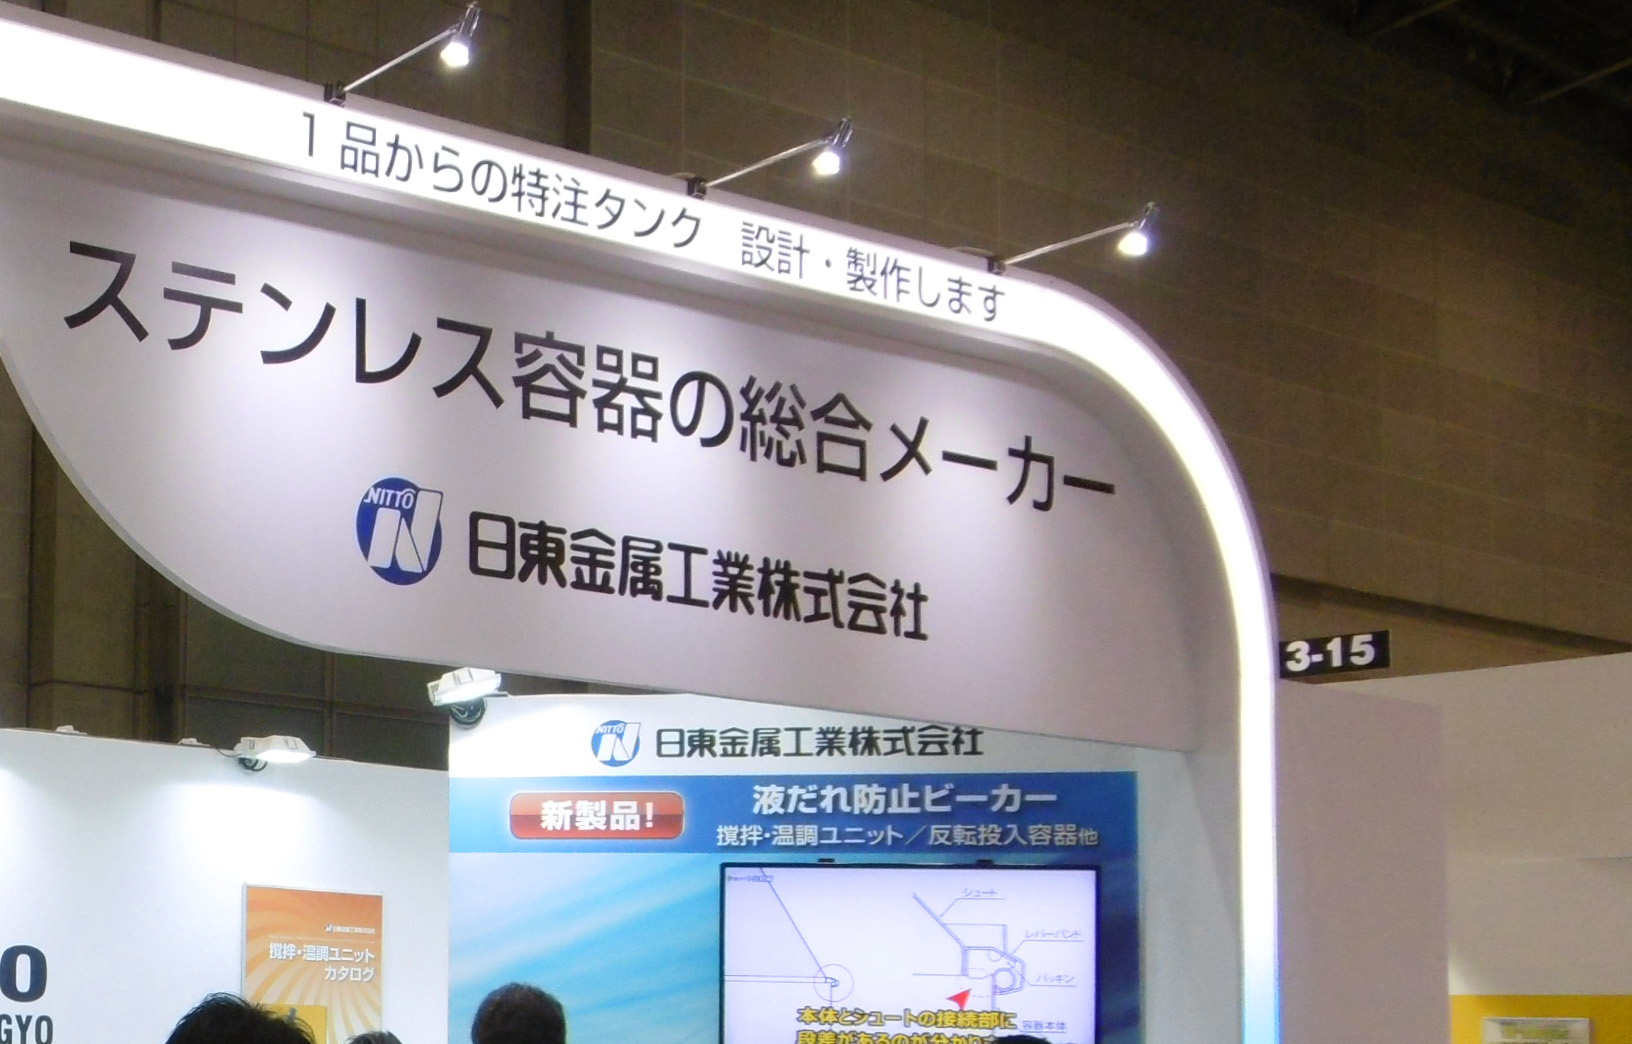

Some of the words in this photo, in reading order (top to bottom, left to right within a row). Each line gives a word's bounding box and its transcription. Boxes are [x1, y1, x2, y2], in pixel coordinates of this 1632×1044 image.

[739, 220, 1006, 322] 設計・製作します
[63, 239, 1116, 512] ステンレス容器の総合メーカー
[363, 487, 417, 510] NITTO
[468, 510, 929, 641] 日東金属工業株式会社
[1285, 634, 1375, 673] 3-15
[656, 725, 985, 757] 日東金属工業株式会社
[540, 799, 655, 831] 新製品!
[751, 783, 1058, 816] 液だれ防止ビーカー
[324, 965, 376, 982] カタログ
[797, 1006, 1019, 1030] 本体とシュートの接続部に
